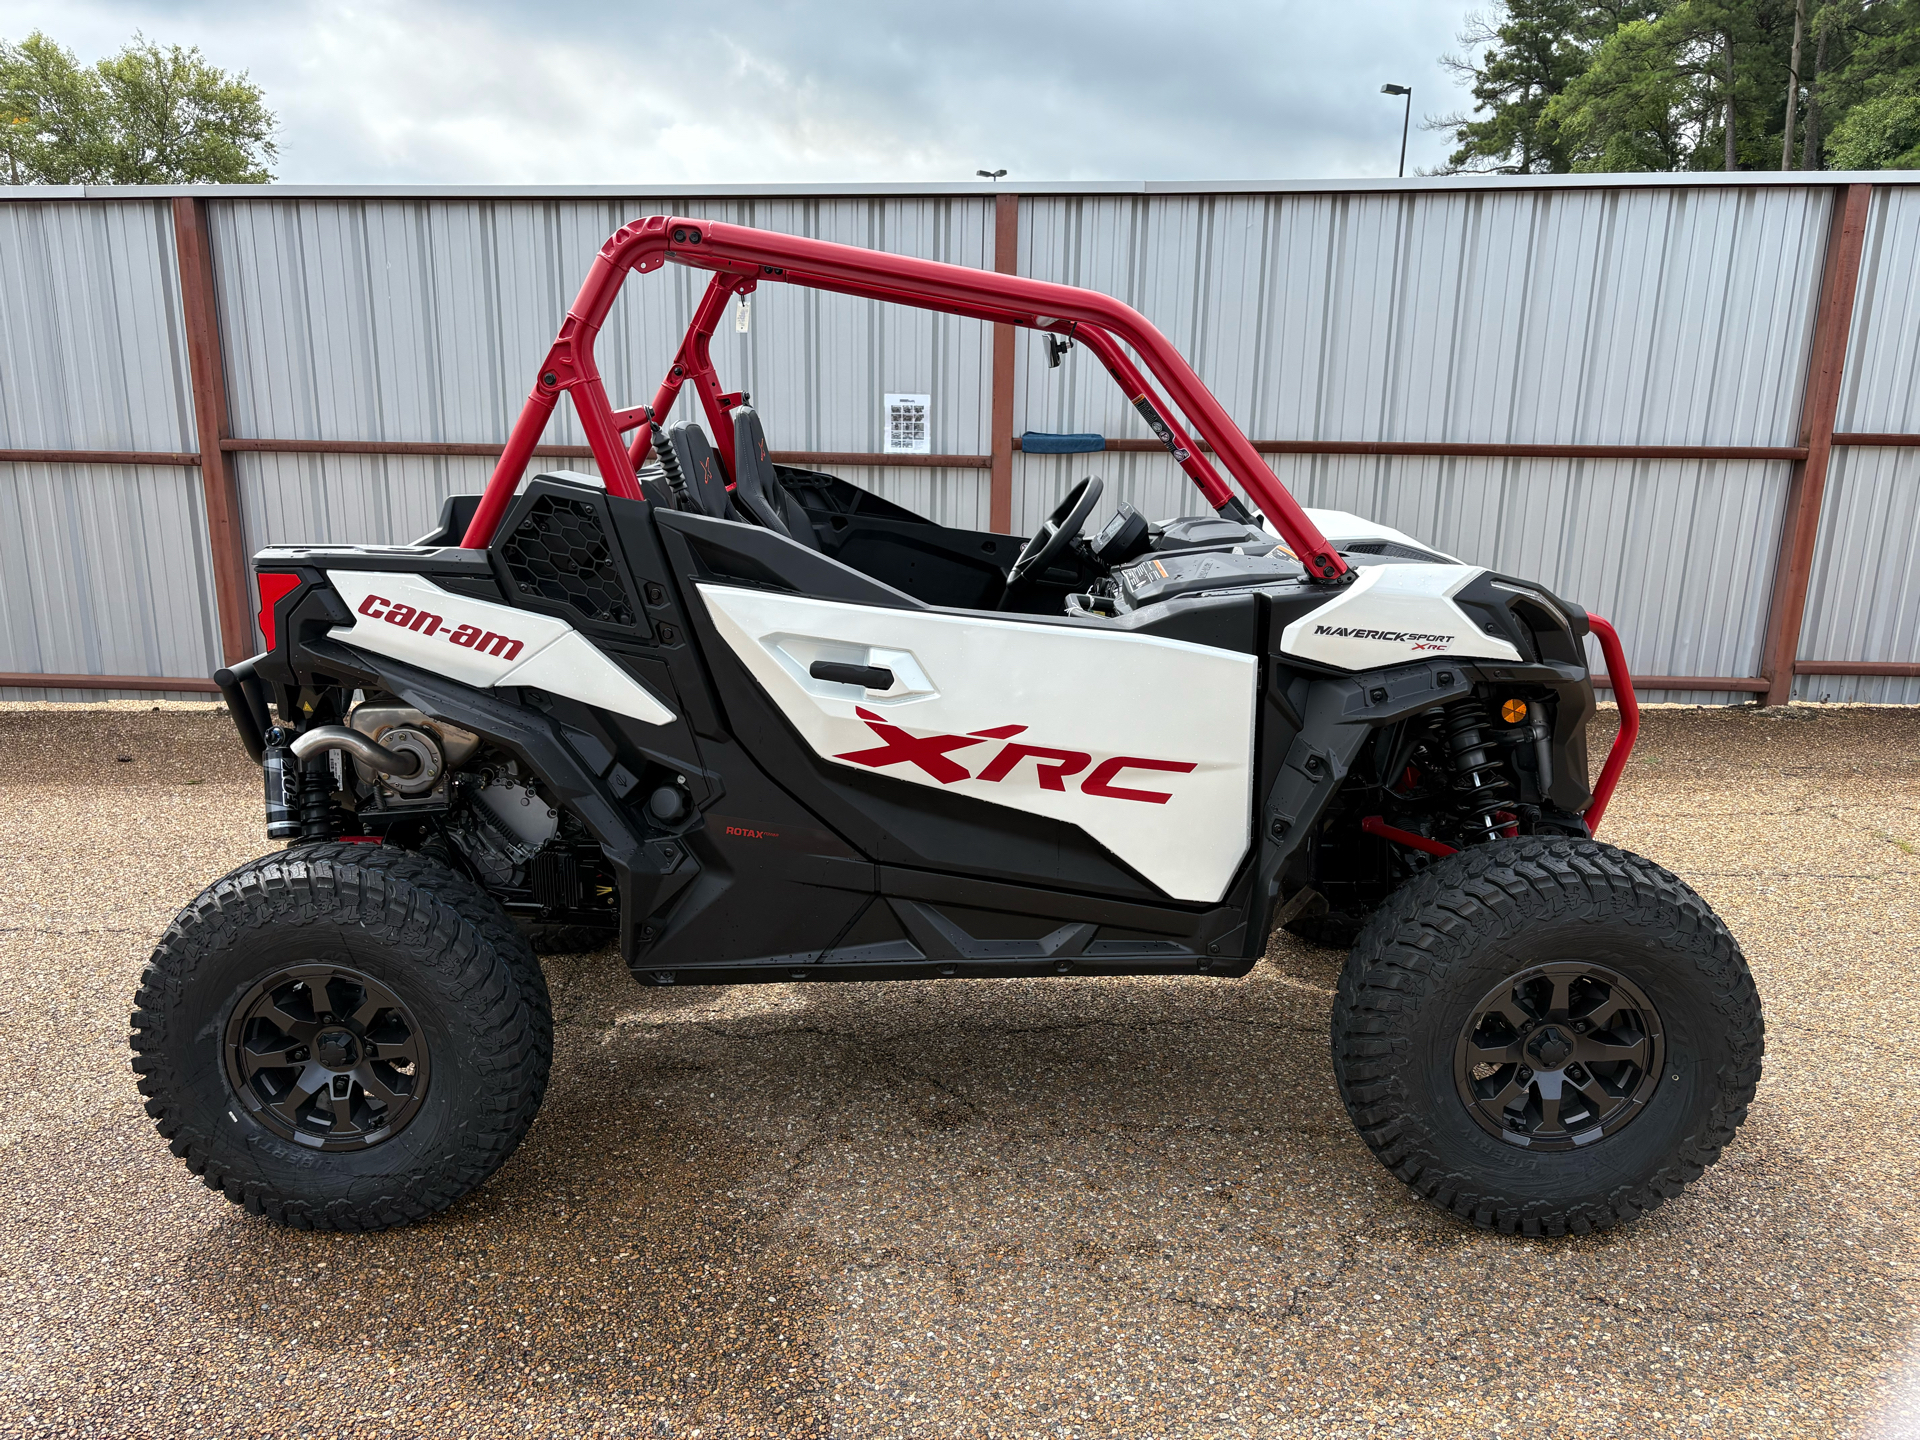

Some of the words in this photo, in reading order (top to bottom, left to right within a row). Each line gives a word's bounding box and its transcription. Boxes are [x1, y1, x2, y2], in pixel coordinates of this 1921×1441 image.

[357, 594, 525, 662] can-am
[1314, 625, 1409, 642] MAVERICK
[1407, 634, 1454, 642] SPORT
[1411, 642, 1448, 651] XRC
[832, 705, 1199, 805] XRC
[281, 758, 299, 810] FOX
[725, 826, 764, 839] ROTAX
[246, 1131, 336, 1171] LIBERTY
[1460, 1127, 1539, 1170] LIBERTY
